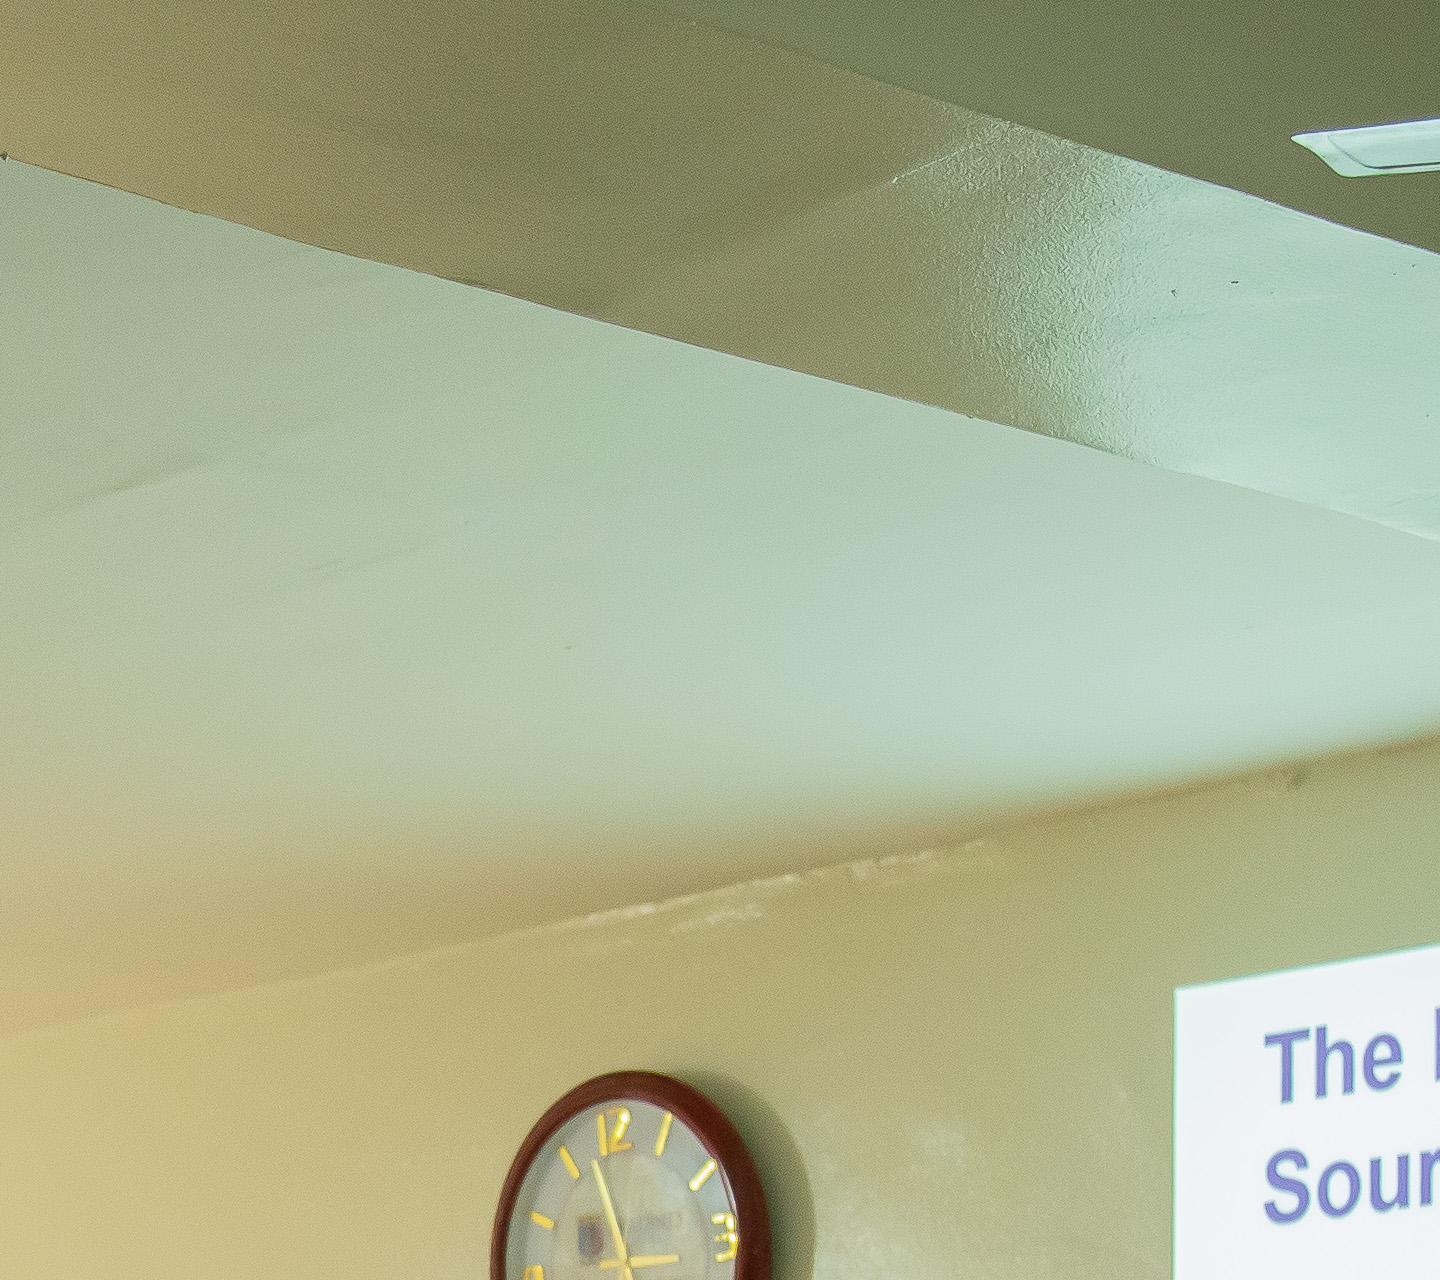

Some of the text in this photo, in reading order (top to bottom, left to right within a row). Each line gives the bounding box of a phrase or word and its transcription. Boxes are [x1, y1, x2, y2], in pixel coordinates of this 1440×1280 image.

[1265, 1025, 1403, 1104] The
[597, 1107, 632, 1156] 12
[712, 1212, 737, 1262] 3
